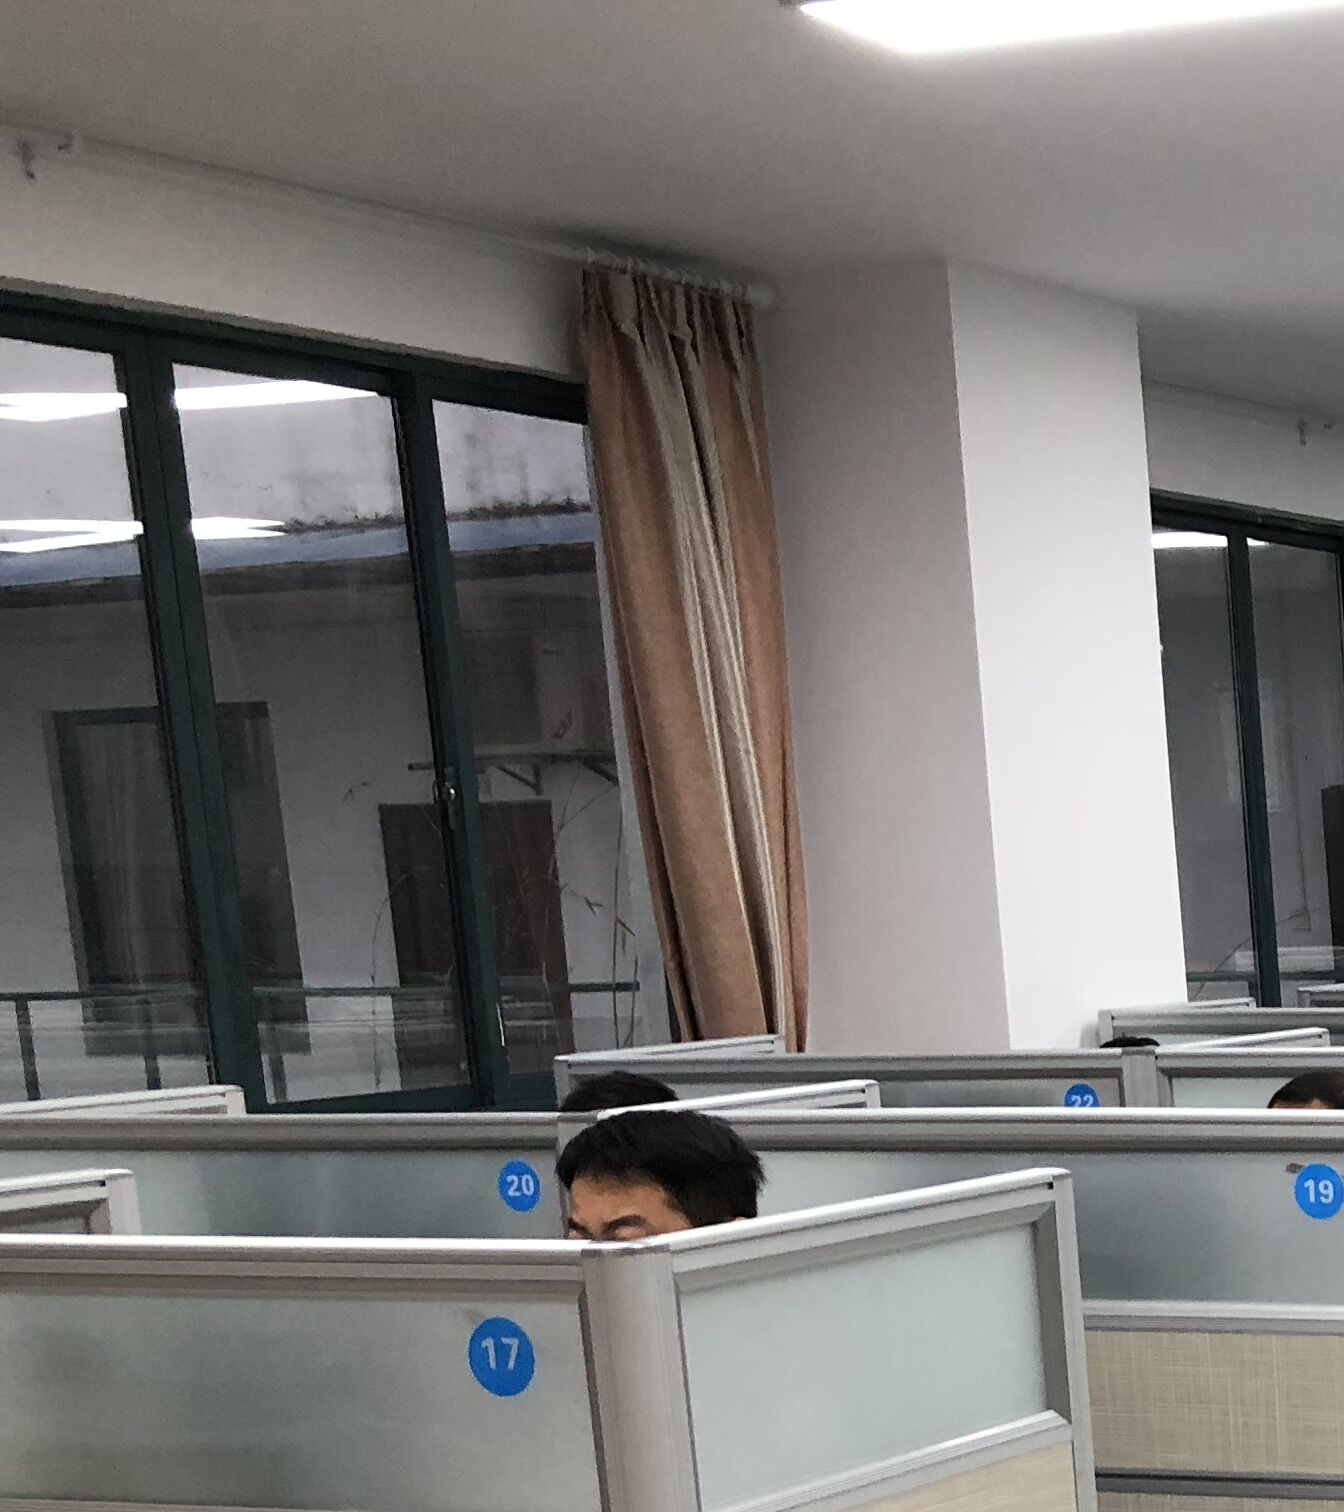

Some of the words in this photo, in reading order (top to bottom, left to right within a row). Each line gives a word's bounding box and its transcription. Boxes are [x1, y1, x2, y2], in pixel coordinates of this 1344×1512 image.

[1071, 1093, 1094, 1107] 22
[506, 1174, 534, 1197] 20
[1303, 1178, 1335, 1205] 19
[480, 1336, 520, 1371] 17
